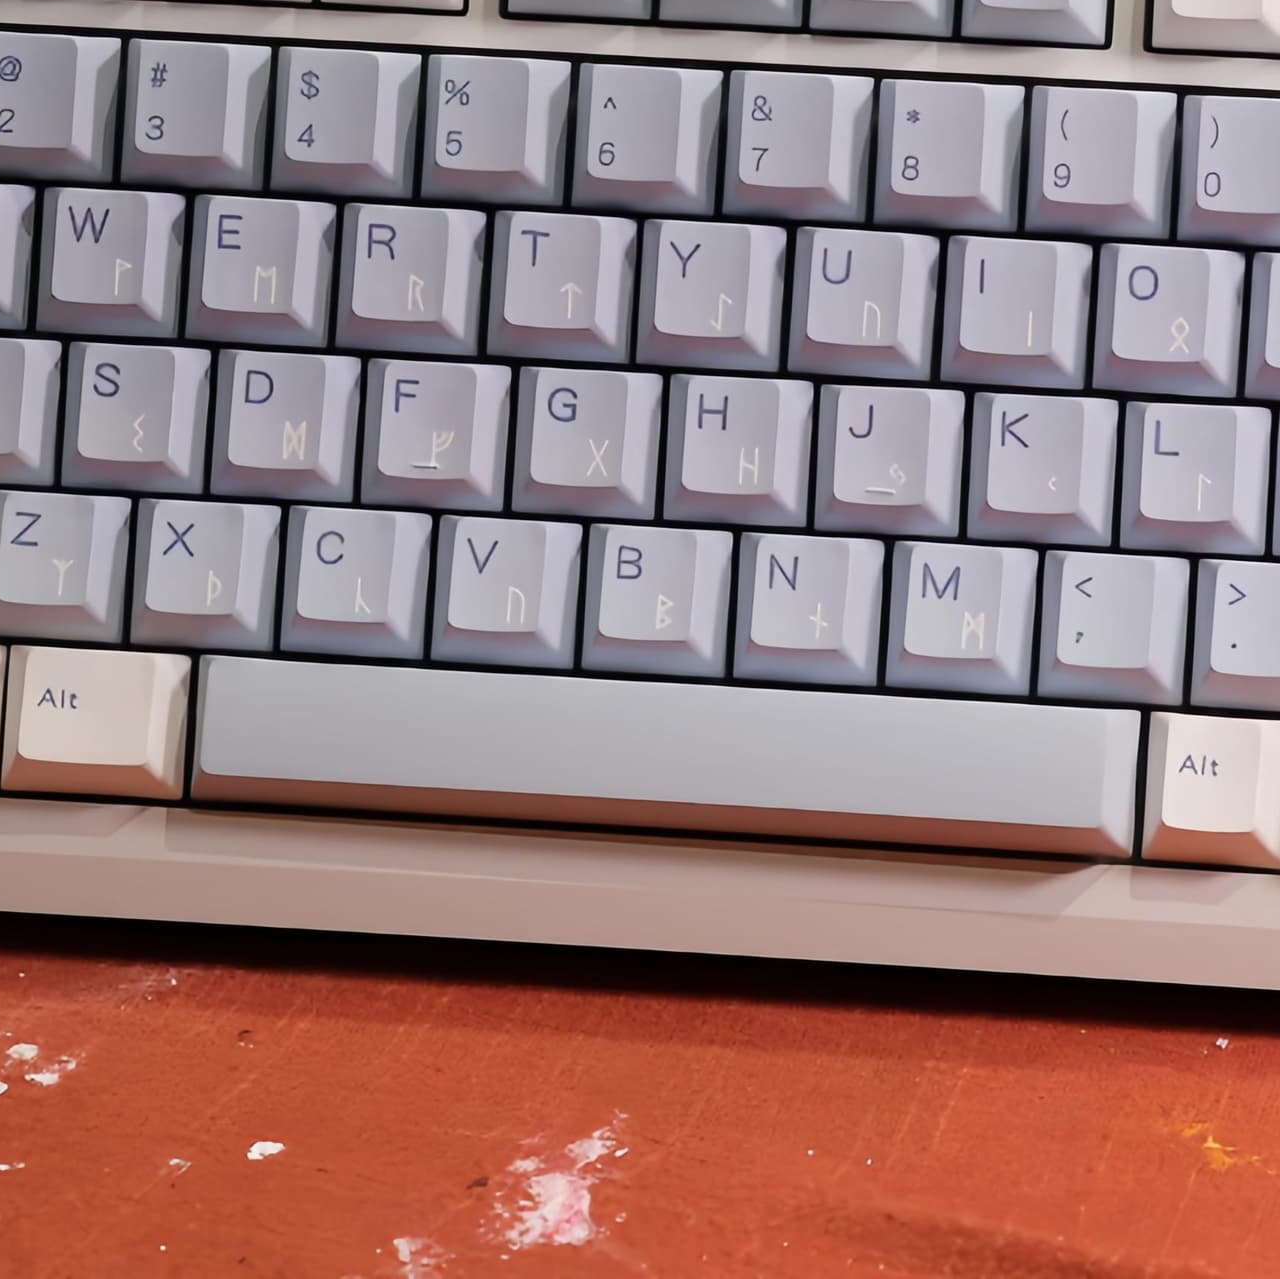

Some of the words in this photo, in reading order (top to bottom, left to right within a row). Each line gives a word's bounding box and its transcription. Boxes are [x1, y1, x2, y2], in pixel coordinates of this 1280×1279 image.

[147, 115, 165, 141] 3
[297, 123, 315, 148] 4
[446, 130, 463, 156] 5
[598, 141, 616, 166] 6
[751, 147, 769, 172] 7
[902, 155, 920, 181] 8
[1053, 163, 1071, 188] 9
[1204, 171, 1221, 197] 0
[70, 207, 110, 244] W
[217, 214, 243, 250] E
[367, 223, 397, 261] R
[521, 230, 551, 268] T
[670, 241, 702, 279] Y
[822, 248, 853, 285] U
[979, 258, 985, 295] I
[1128, 265, 1159, 301] O
[93, 362, 121, 398] S
[244, 370, 274, 404] D
[394, 379, 420, 413] F
[547, 387, 578, 423] G
[697, 394, 729, 431] H
[848, 404, 874, 439] J
[1001, 412, 1029, 449] K
[1154, 421, 1180, 457] L
[10, 511, 42, 547] Z
[162, 521, 195, 558] X
[316, 530, 345, 565] C
[467, 538, 499, 575] V
[616, 545, 643, 580] B
[768, 554, 799, 591] N
[921, 563, 961, 601] M
[37, 687, 78, 710] Alt
[1178, 754, 1219, 777] Alt
